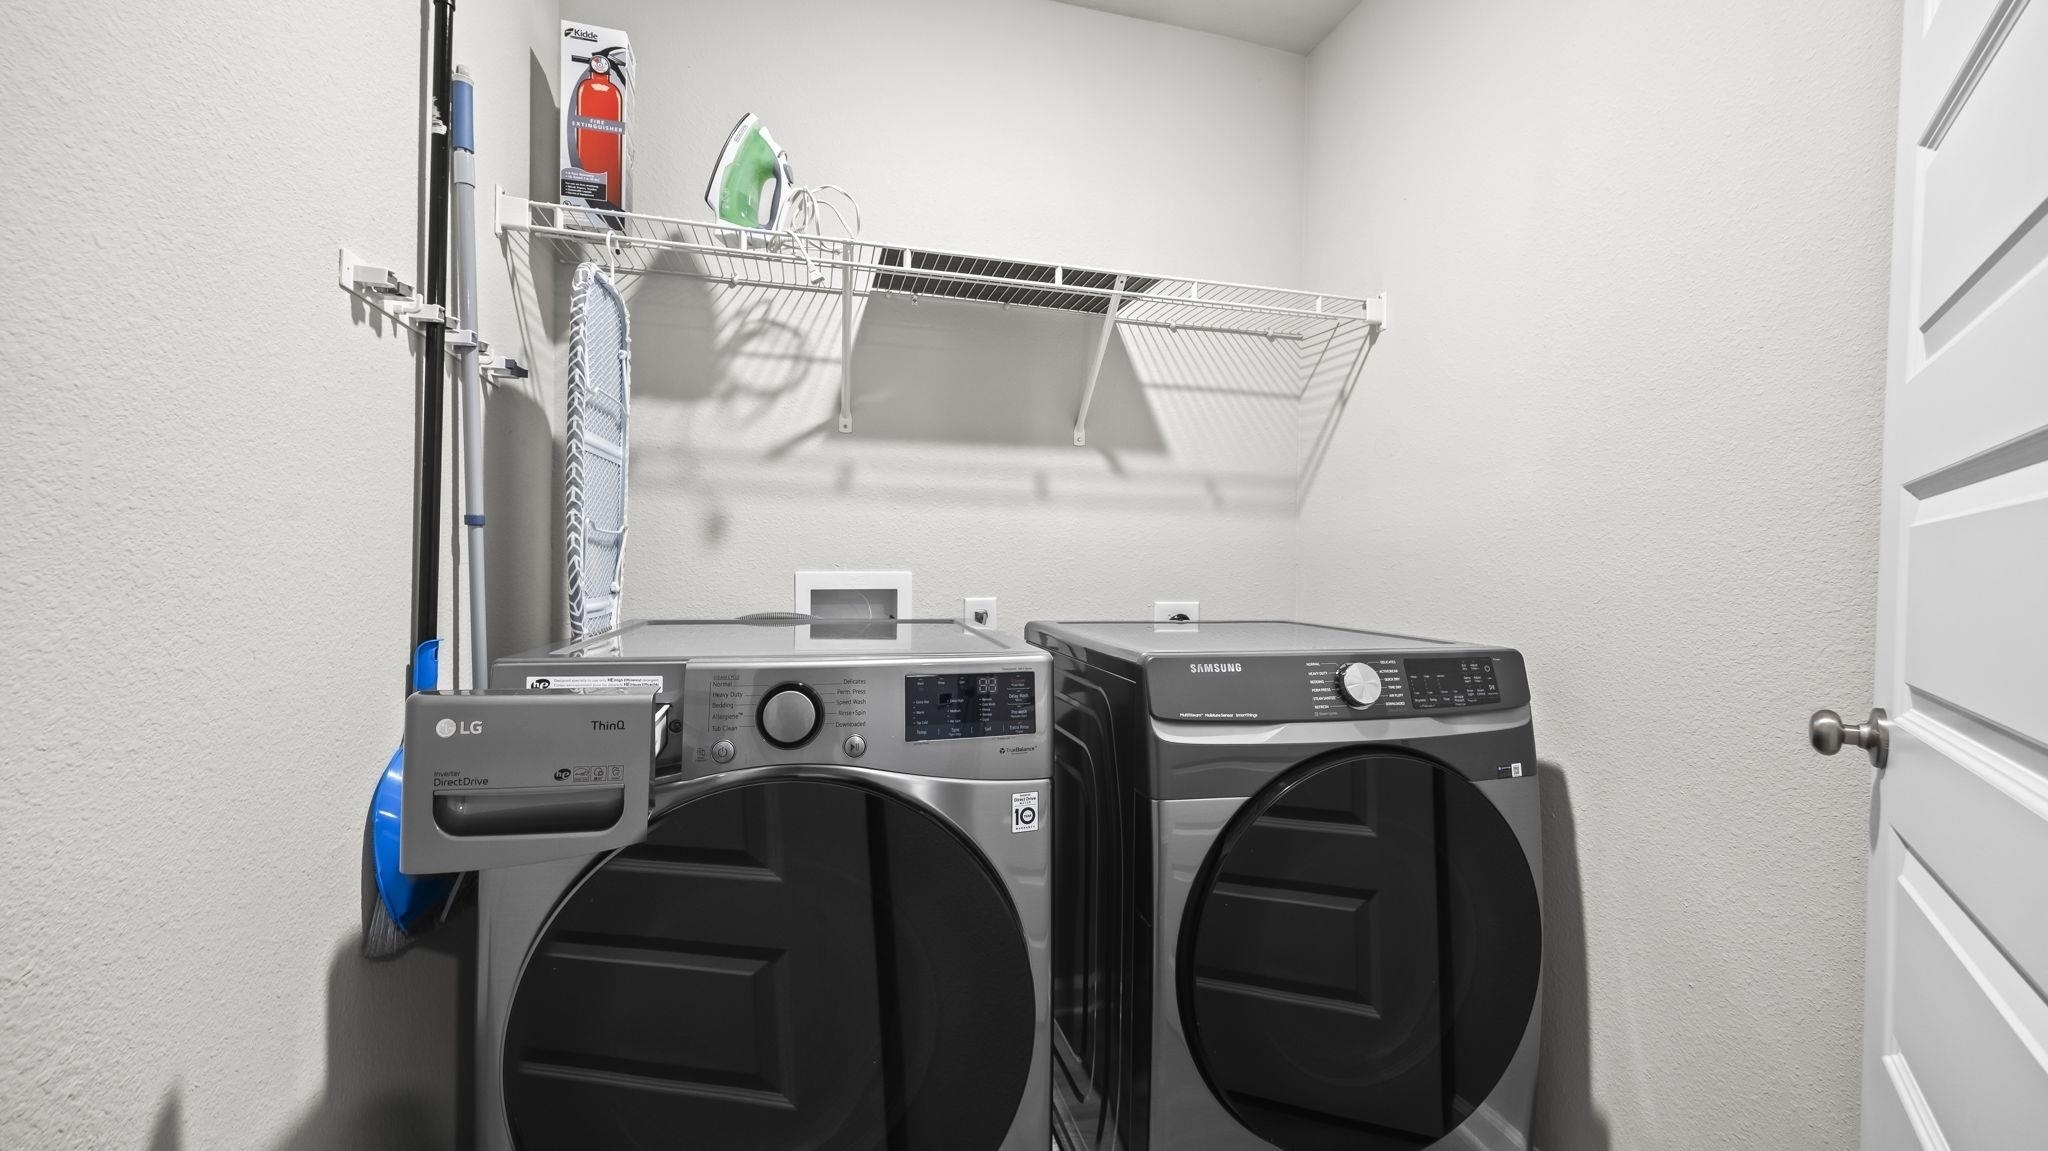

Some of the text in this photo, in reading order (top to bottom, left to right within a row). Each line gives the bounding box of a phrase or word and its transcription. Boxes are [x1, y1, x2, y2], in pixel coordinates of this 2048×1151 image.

[574, 29, 598, 39] Kidde
[571, 120, 623, 133] EXTINGUISHER
[1190, 663, 1242, 673] SAMSUNG
[460, 721, 483, 735] LG
[591, 719, 626, 731] ThinQ
[1015, 807, 1035, 825] 10
